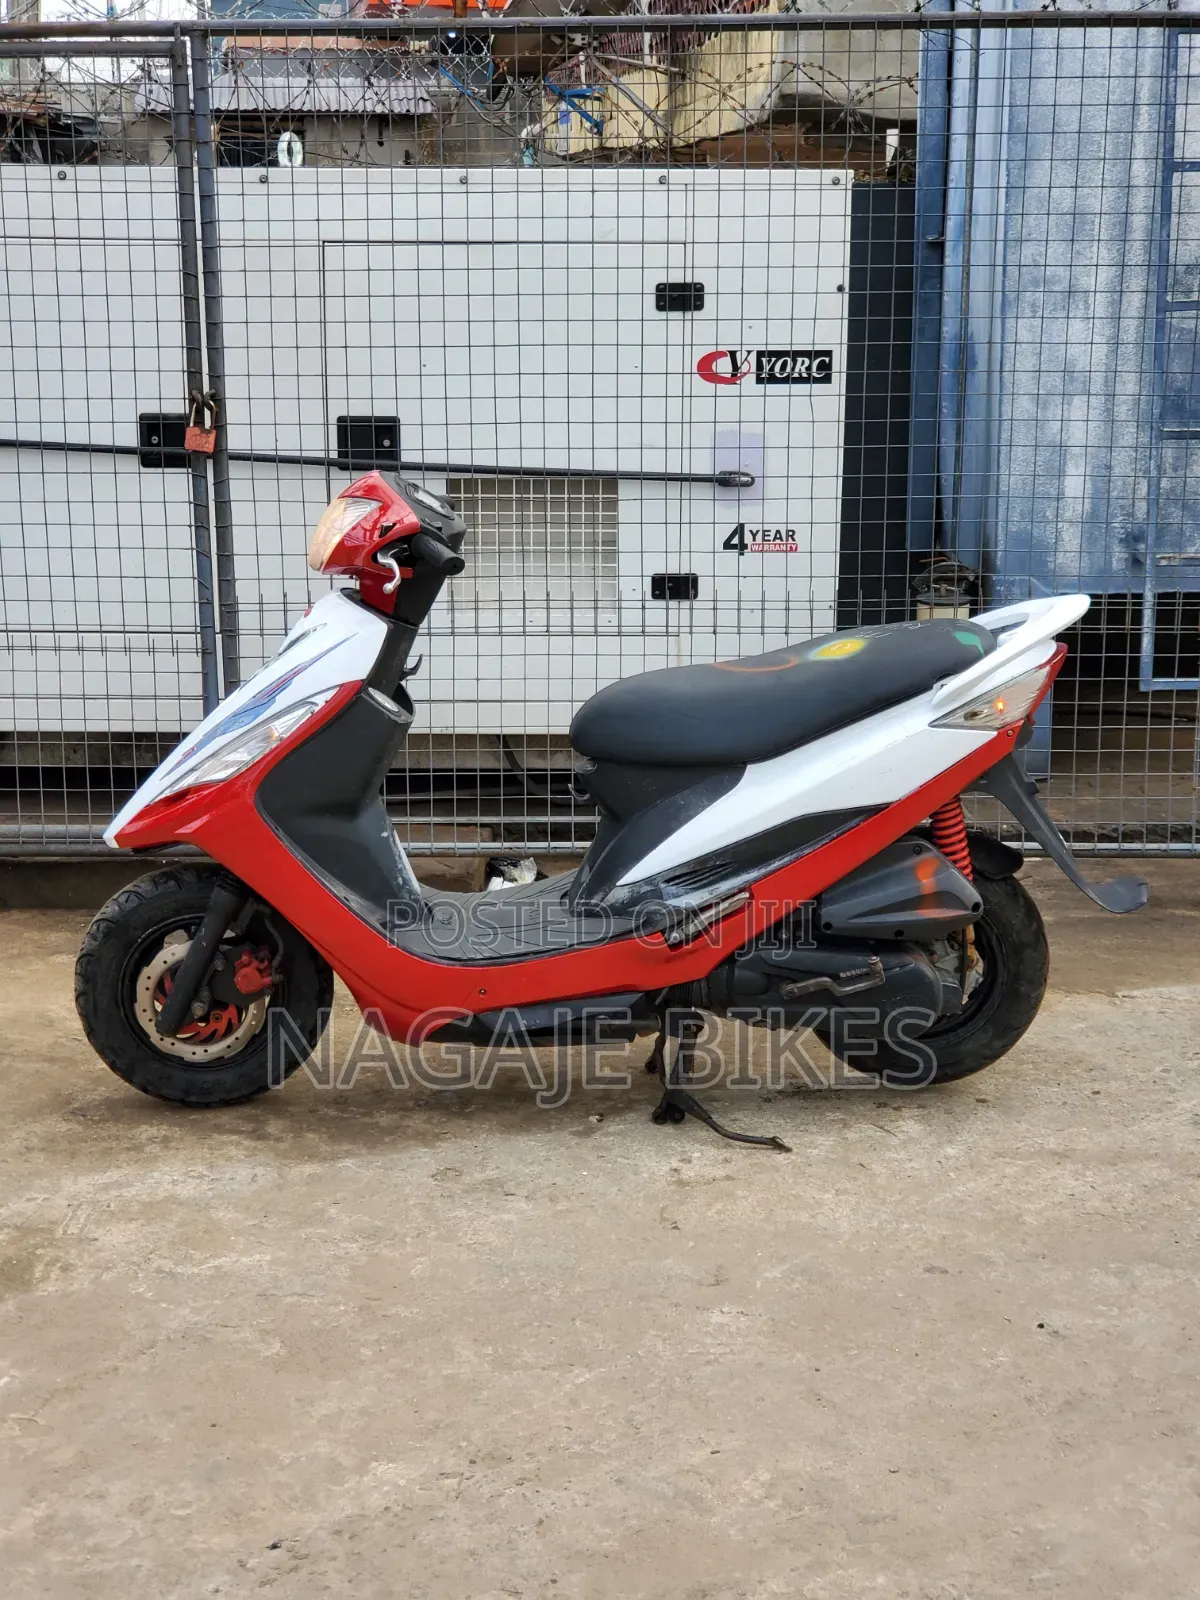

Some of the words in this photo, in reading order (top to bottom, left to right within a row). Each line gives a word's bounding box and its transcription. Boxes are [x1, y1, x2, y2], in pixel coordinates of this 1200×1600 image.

[760, 356, 829, 378] YORC
[723, 523, 748, 556] 4
[749, 529, 797, 542] YEAR
[751, 543, 798, 552] WARRANTY
